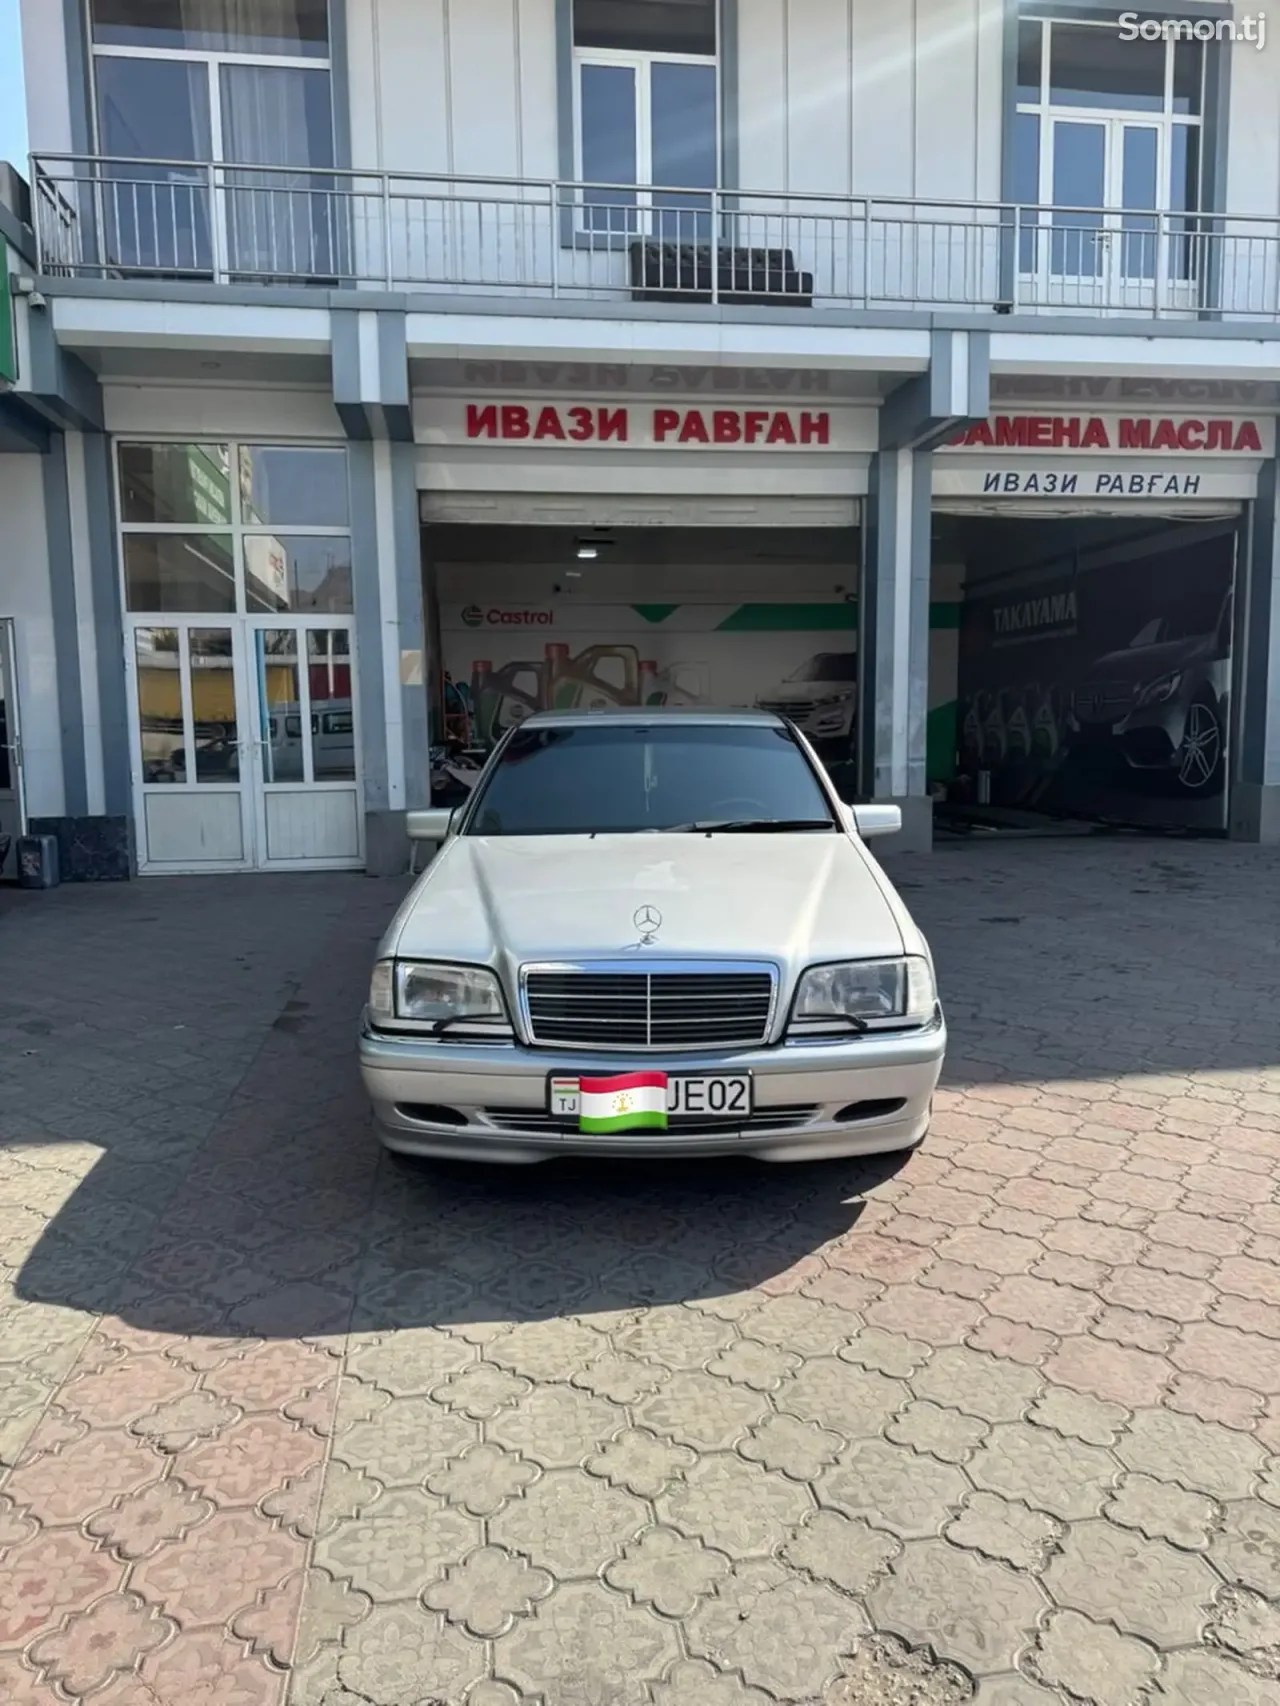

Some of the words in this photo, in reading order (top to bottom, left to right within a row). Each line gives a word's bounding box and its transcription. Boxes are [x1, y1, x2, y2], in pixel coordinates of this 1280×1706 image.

[466, 404, 628, 442] ИВАЗИ
[1118, 418, 1262, 451] МАСЛА
[983, 472, 1079, 493] ИВАЗИ
[486, 608, 554, 625] Castrol
[993, 590, 1077, 632] TAKAYAMA
[559, 1098, 577, 1111] TJ
